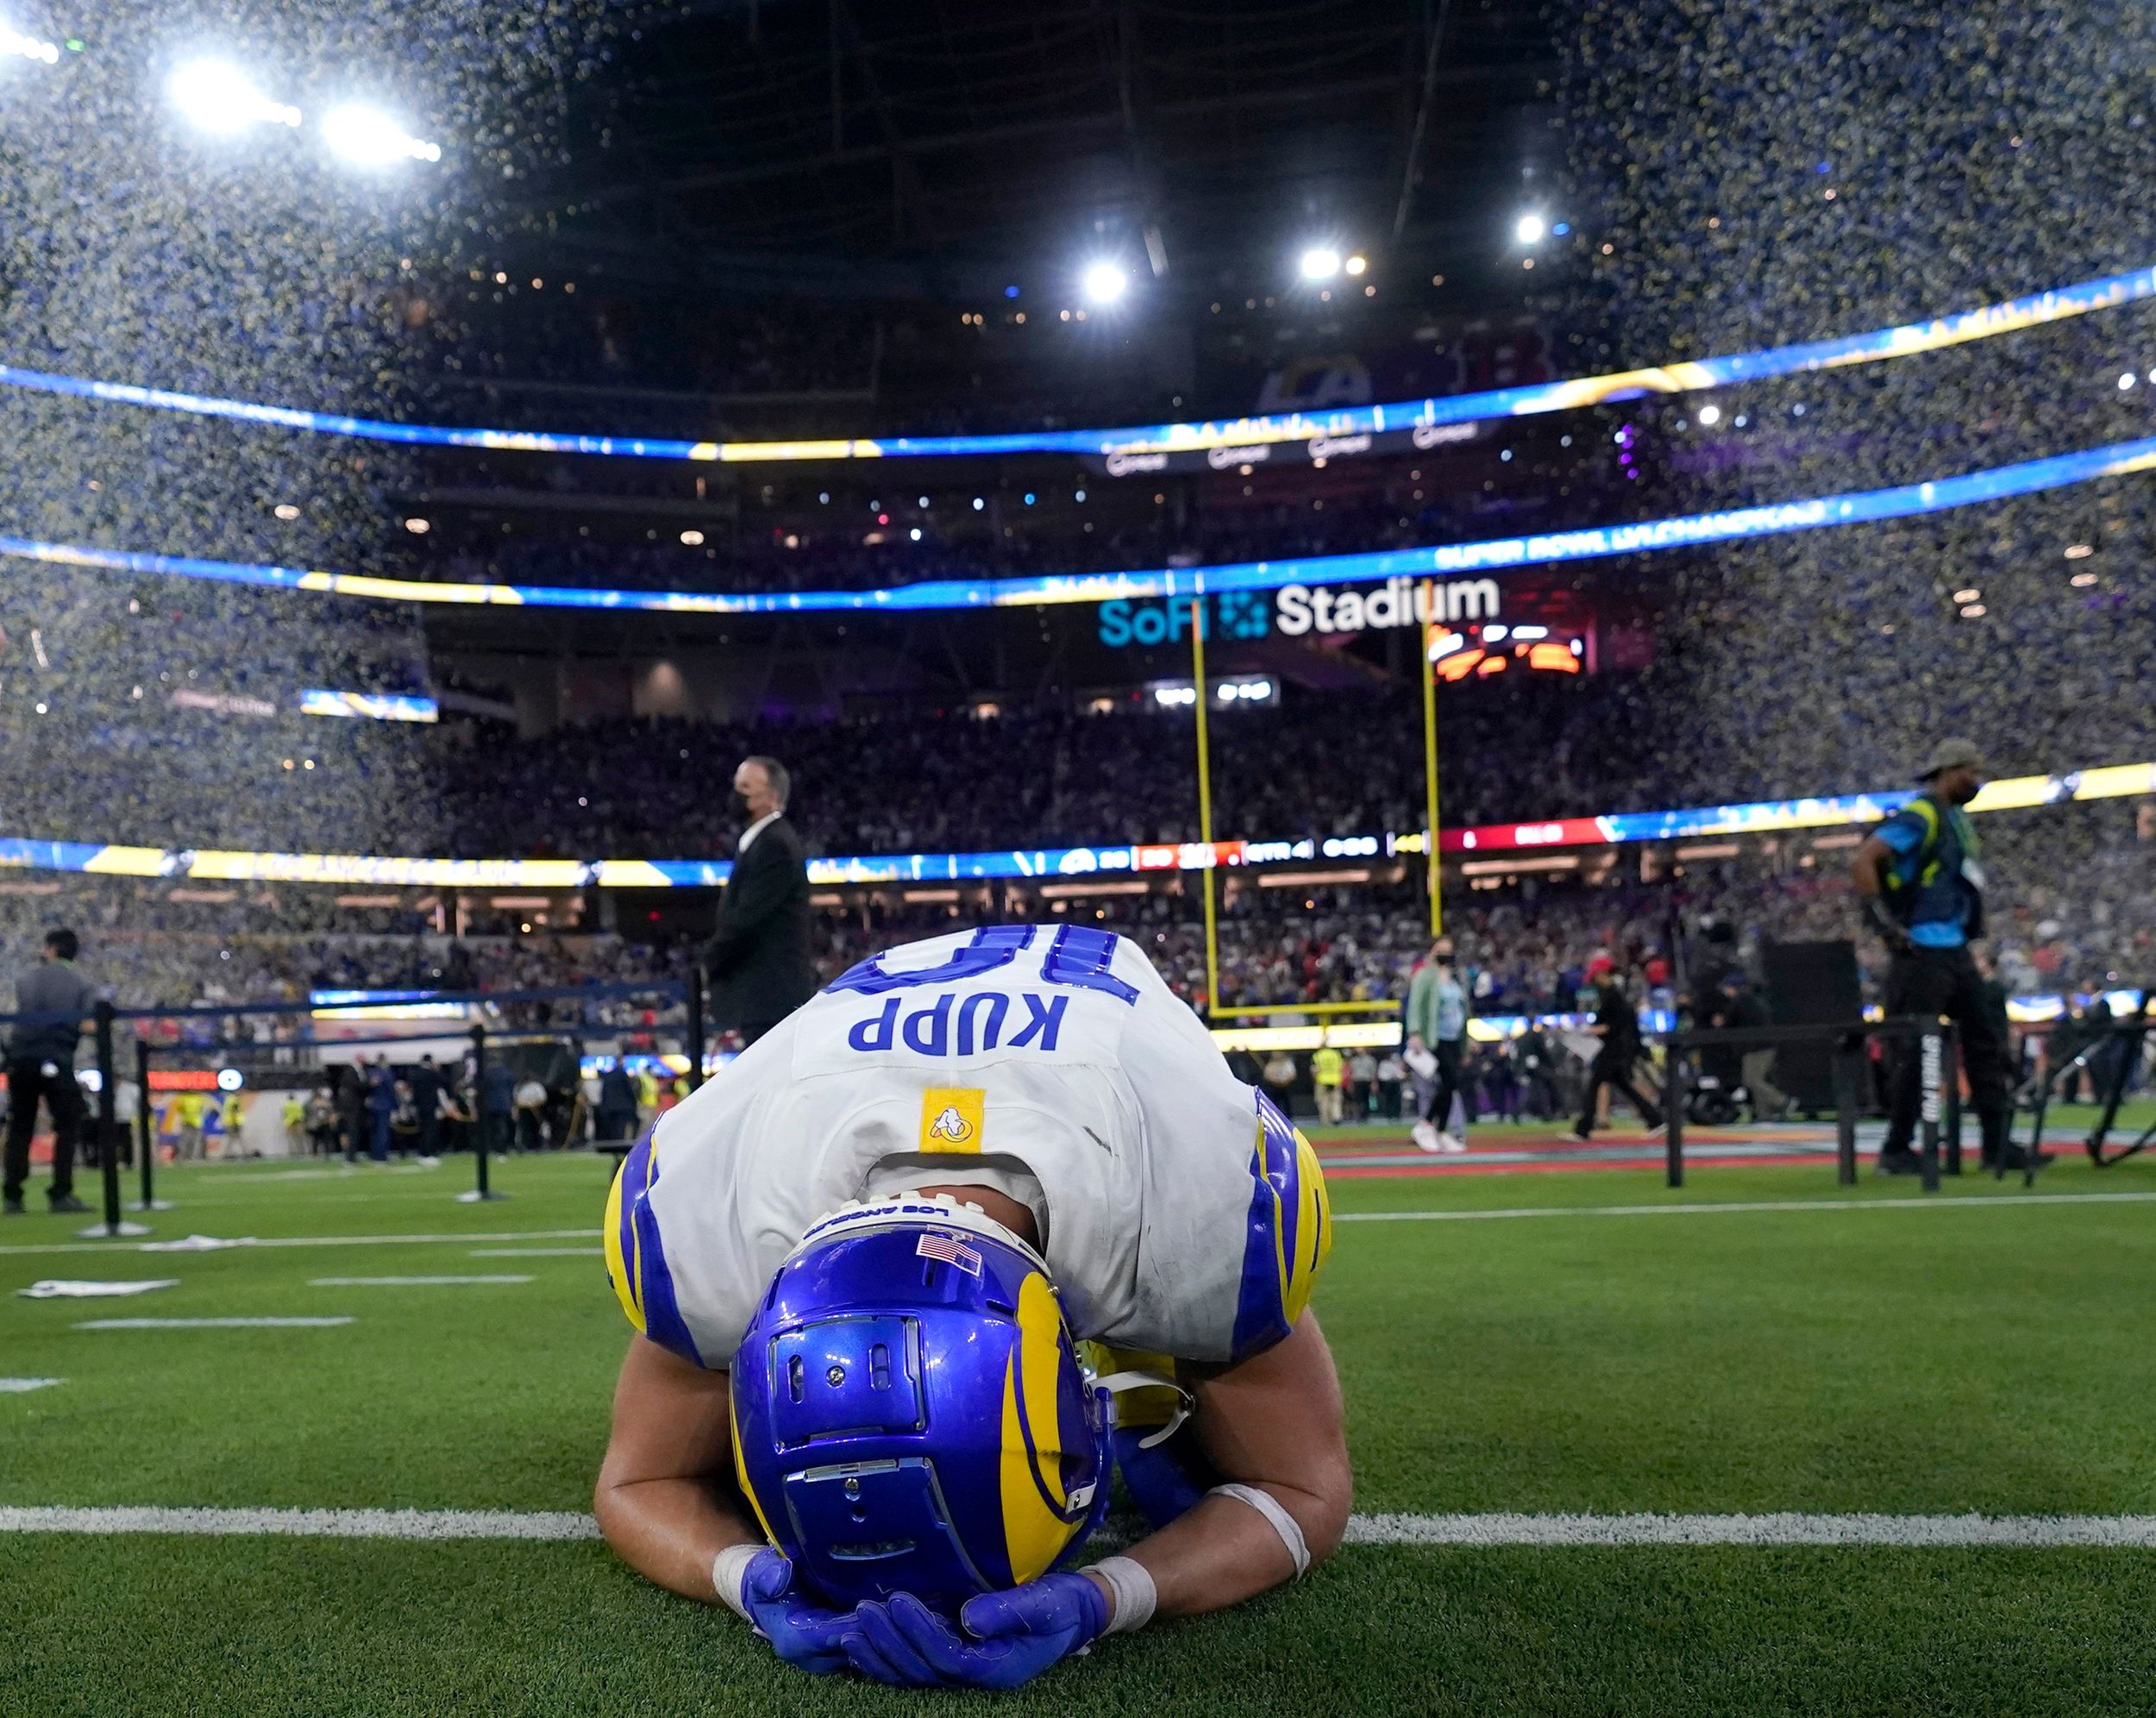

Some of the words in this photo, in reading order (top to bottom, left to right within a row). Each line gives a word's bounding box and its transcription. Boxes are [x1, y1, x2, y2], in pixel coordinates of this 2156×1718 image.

[1099, 593, 1208, 647] SoFi
[1276, 575, 1501, 636] Stadium
[848, 992, 1069, 1057] KUPP
[901, 1205, 950, 1217] LOS
